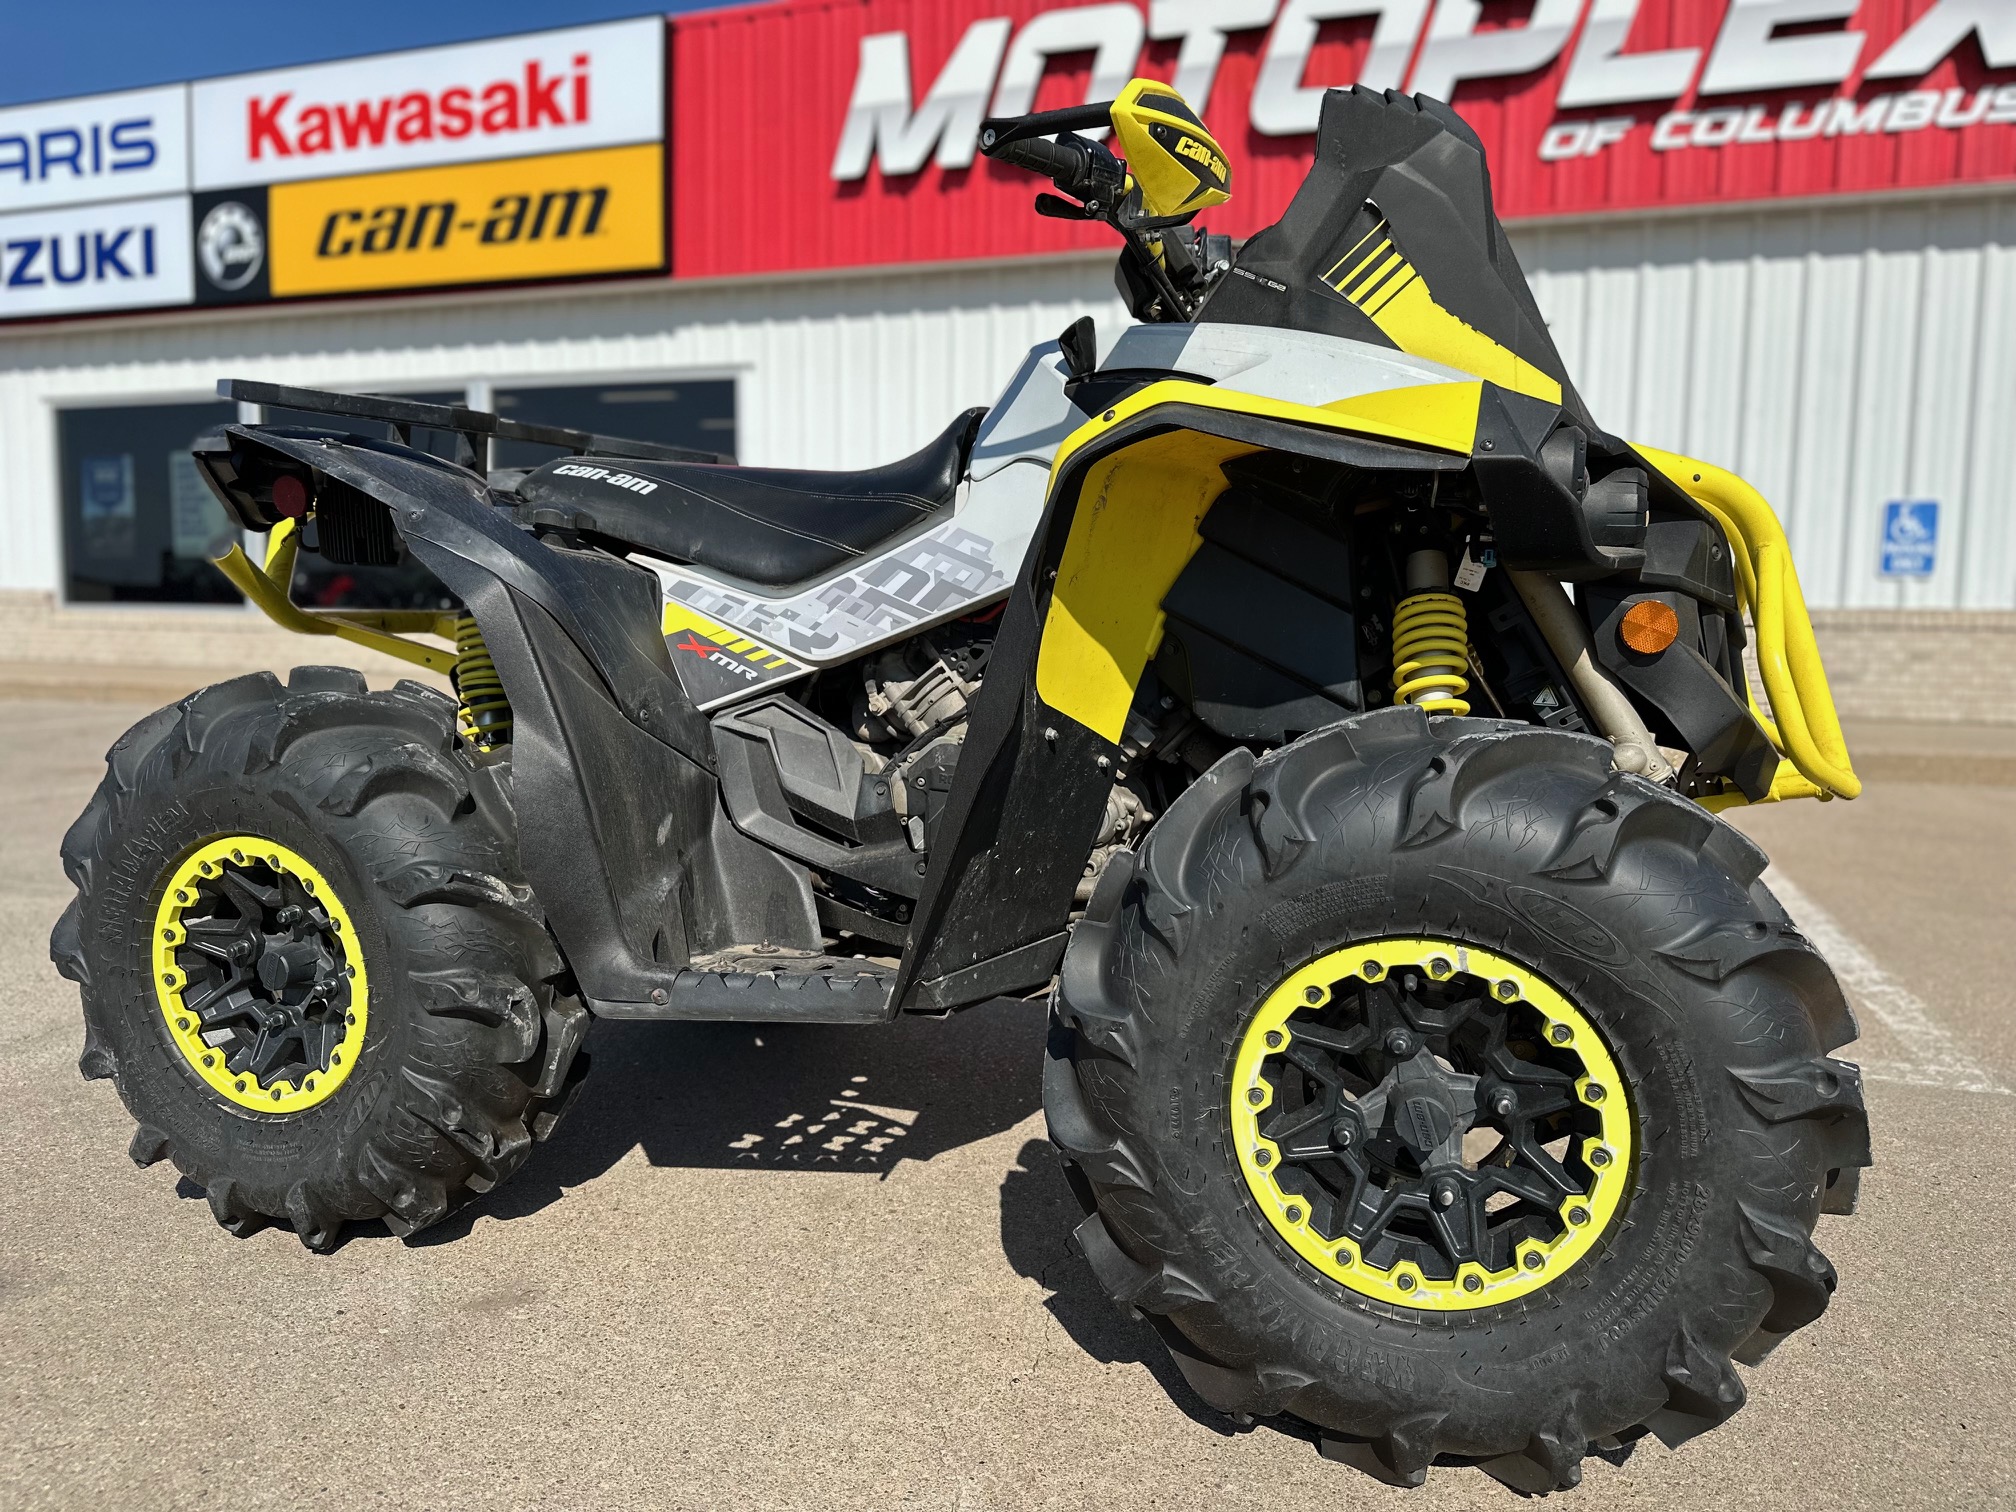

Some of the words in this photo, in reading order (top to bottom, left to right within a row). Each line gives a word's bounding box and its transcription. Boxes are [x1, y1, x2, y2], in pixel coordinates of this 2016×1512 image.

[248, 53, 591, 162] Kawasaki
[1539, 116, 1635, 161] OF
[1650, 84, 2016, 152] COLUMBUS
[1174, 136, 1227, 184] can-am
[315, 184, 611, 259] can-am
[552, 464, 658, 495] can-am
[1527, 900, 1607, 948] ITP
[1412, 1100, 1434, 1148] can-am
